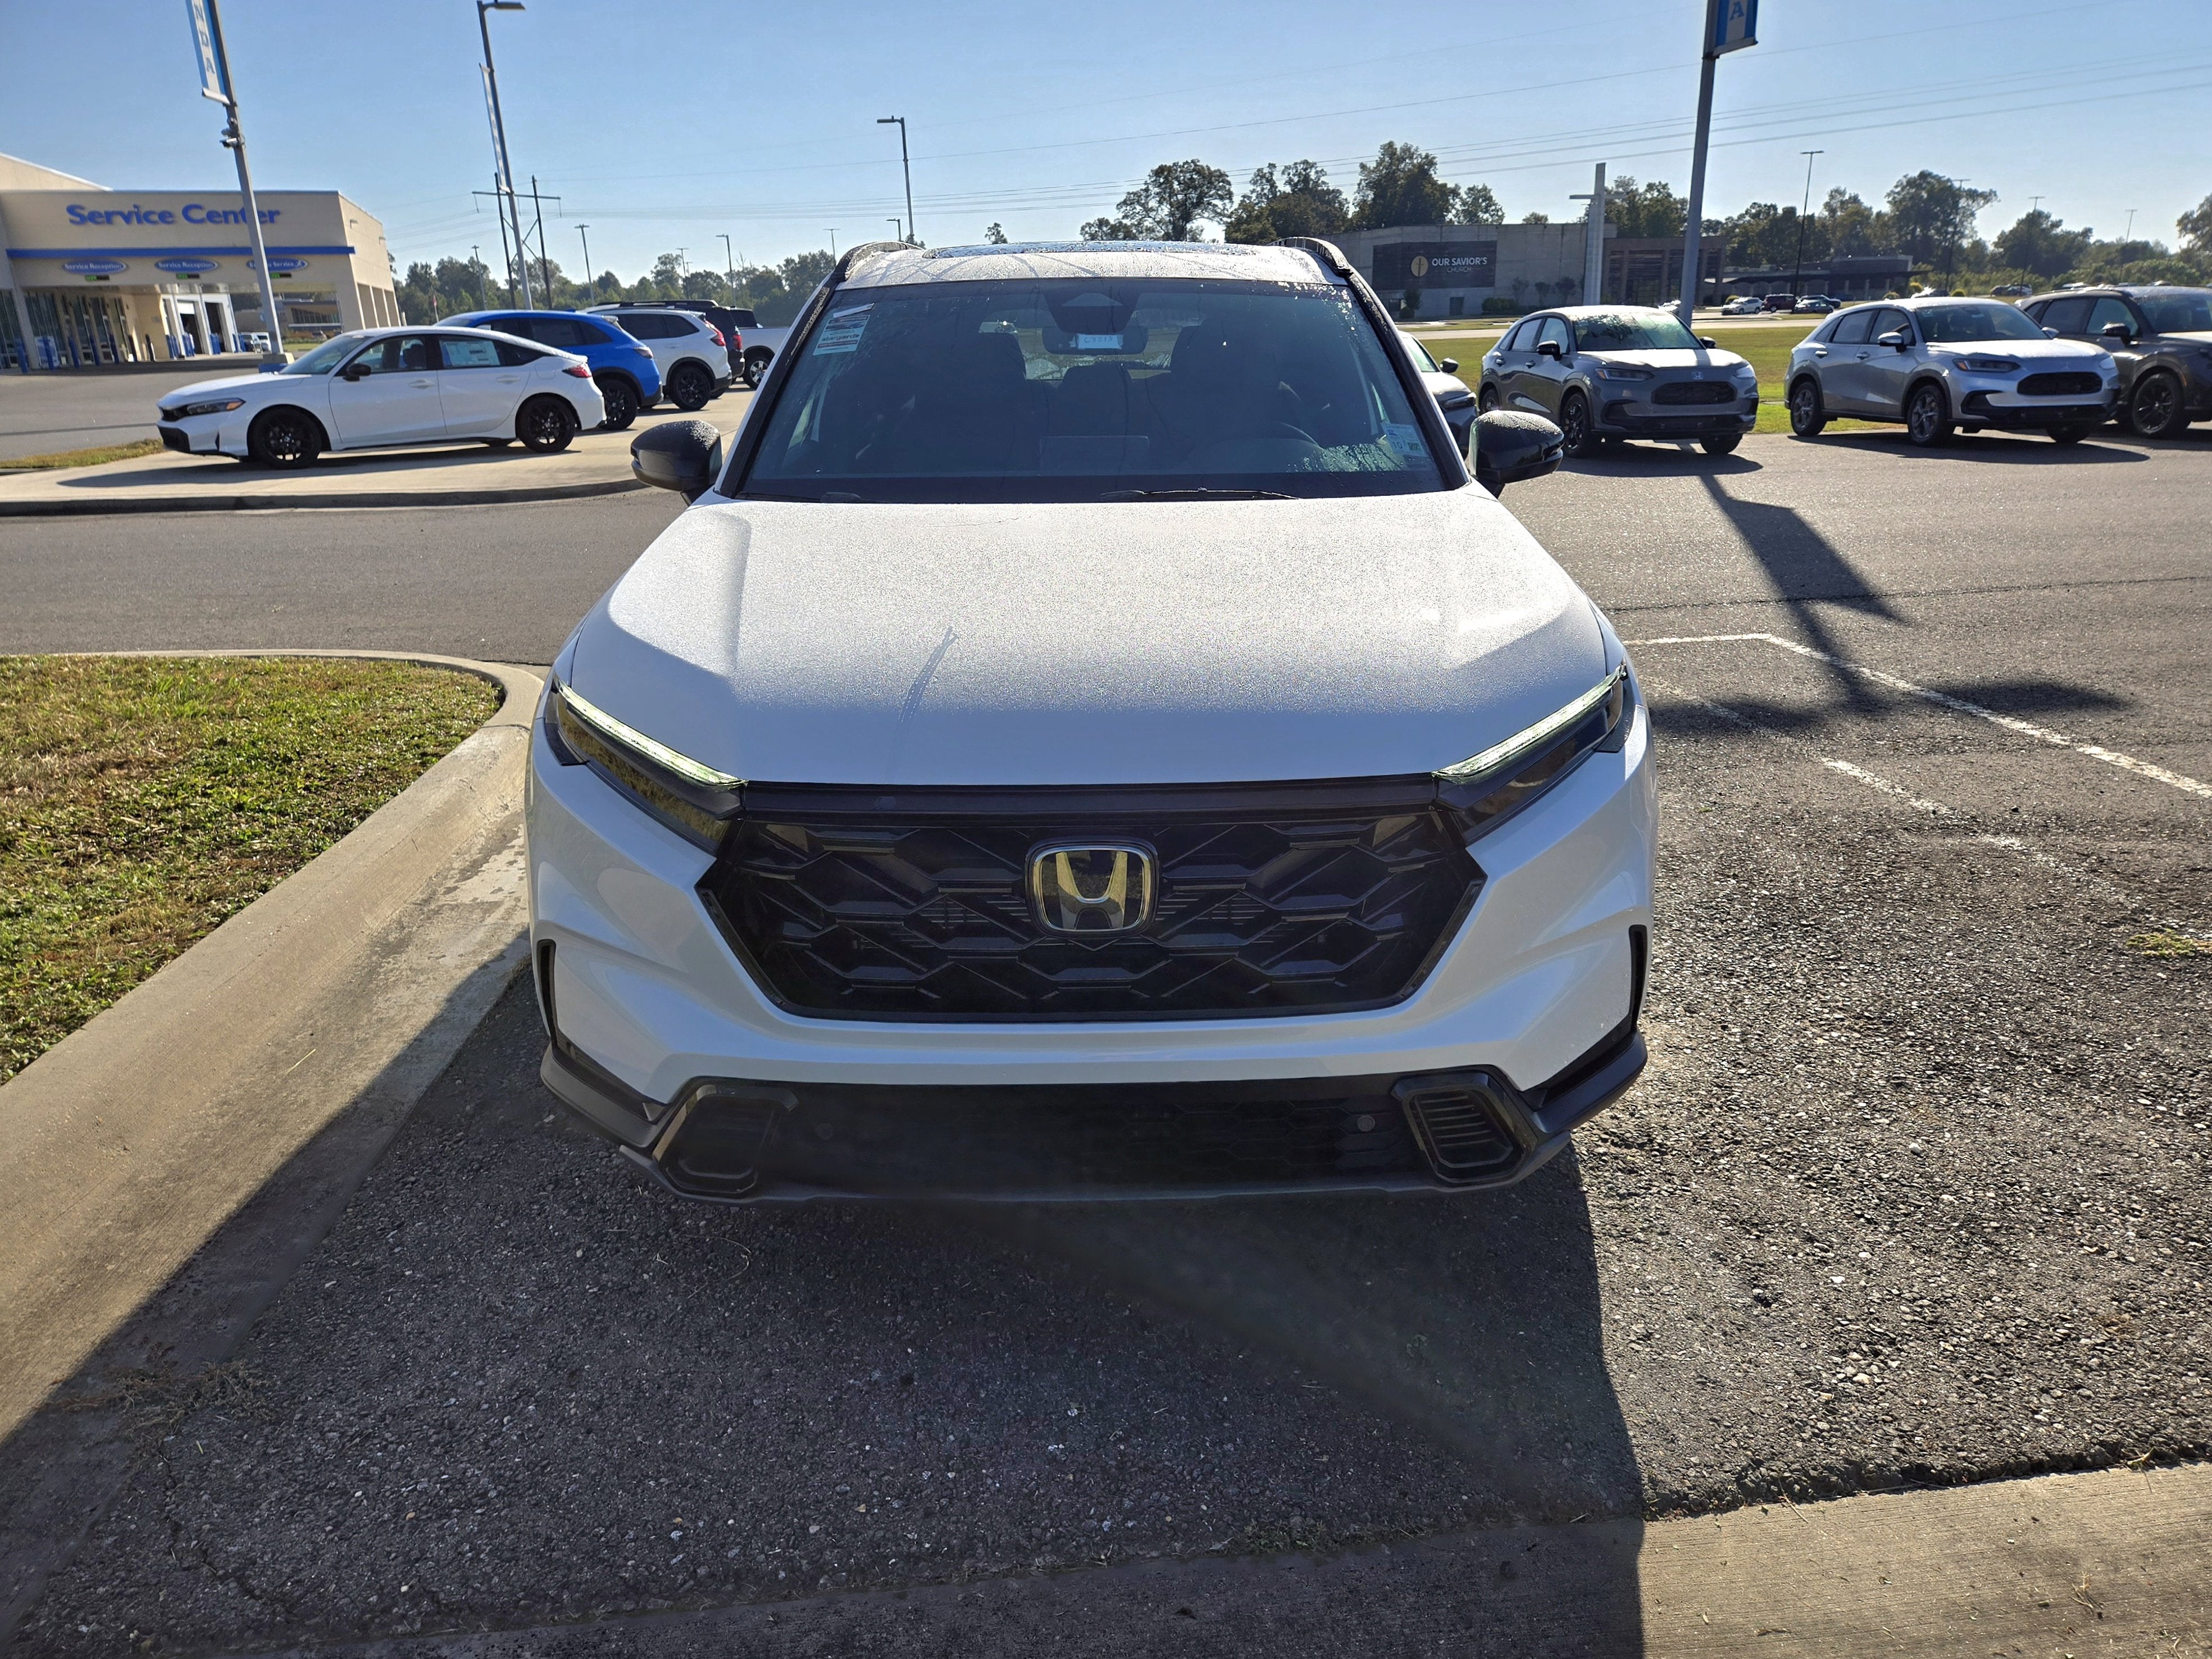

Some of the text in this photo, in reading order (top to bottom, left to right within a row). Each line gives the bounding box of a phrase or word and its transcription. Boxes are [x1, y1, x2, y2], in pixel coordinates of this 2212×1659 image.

[66, 204, 175, 225] Service
[1431, 257, 1487, 266] OUR SAVIOR'S
